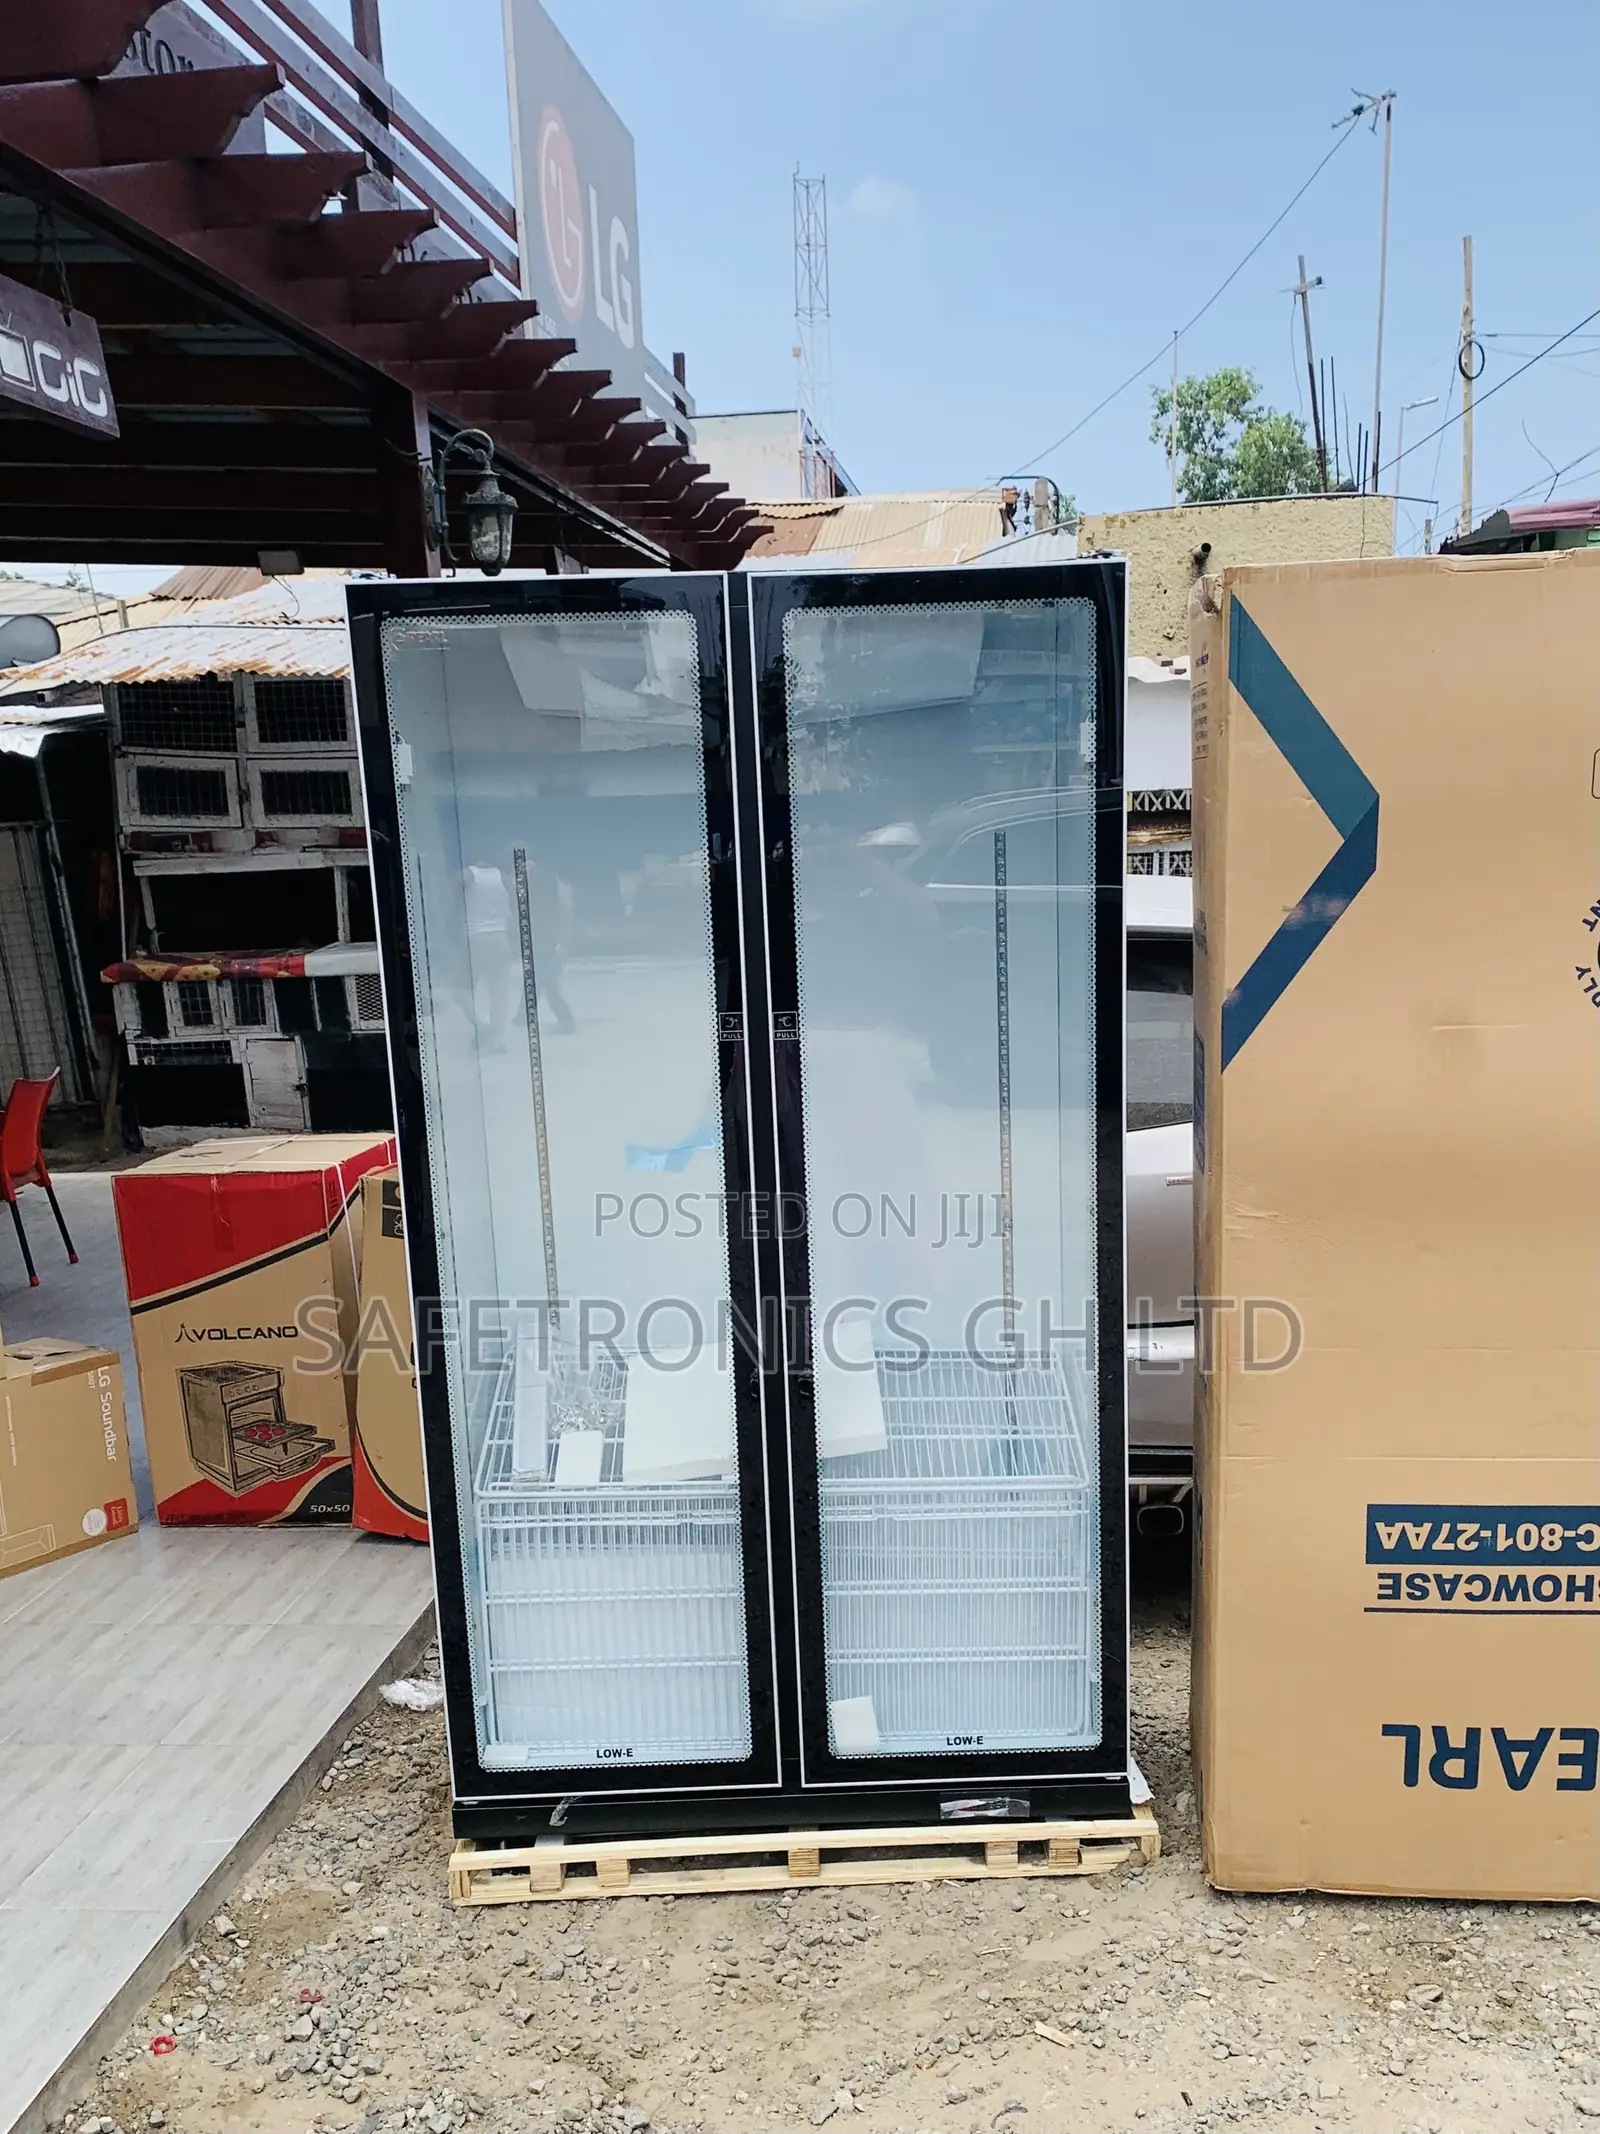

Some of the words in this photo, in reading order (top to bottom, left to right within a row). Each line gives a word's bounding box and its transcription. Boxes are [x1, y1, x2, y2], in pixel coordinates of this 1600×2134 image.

[588, 183, 635, 350] LG
[191, 1325, 299, 1341] VOLCANO
[97, 1366, 111, 1388] LG
[100, 1391, 117, 1462] Soundbar
[310, 1504, 351, 1513] 50x50
[1377, 1572, 1600, 1603] HOWCASE
[946, 1735, 984, 1746] LOW-E
[596, 1748, 634, 1759] LOW-E
[1382, 1723, 1600, 1792] EARL
